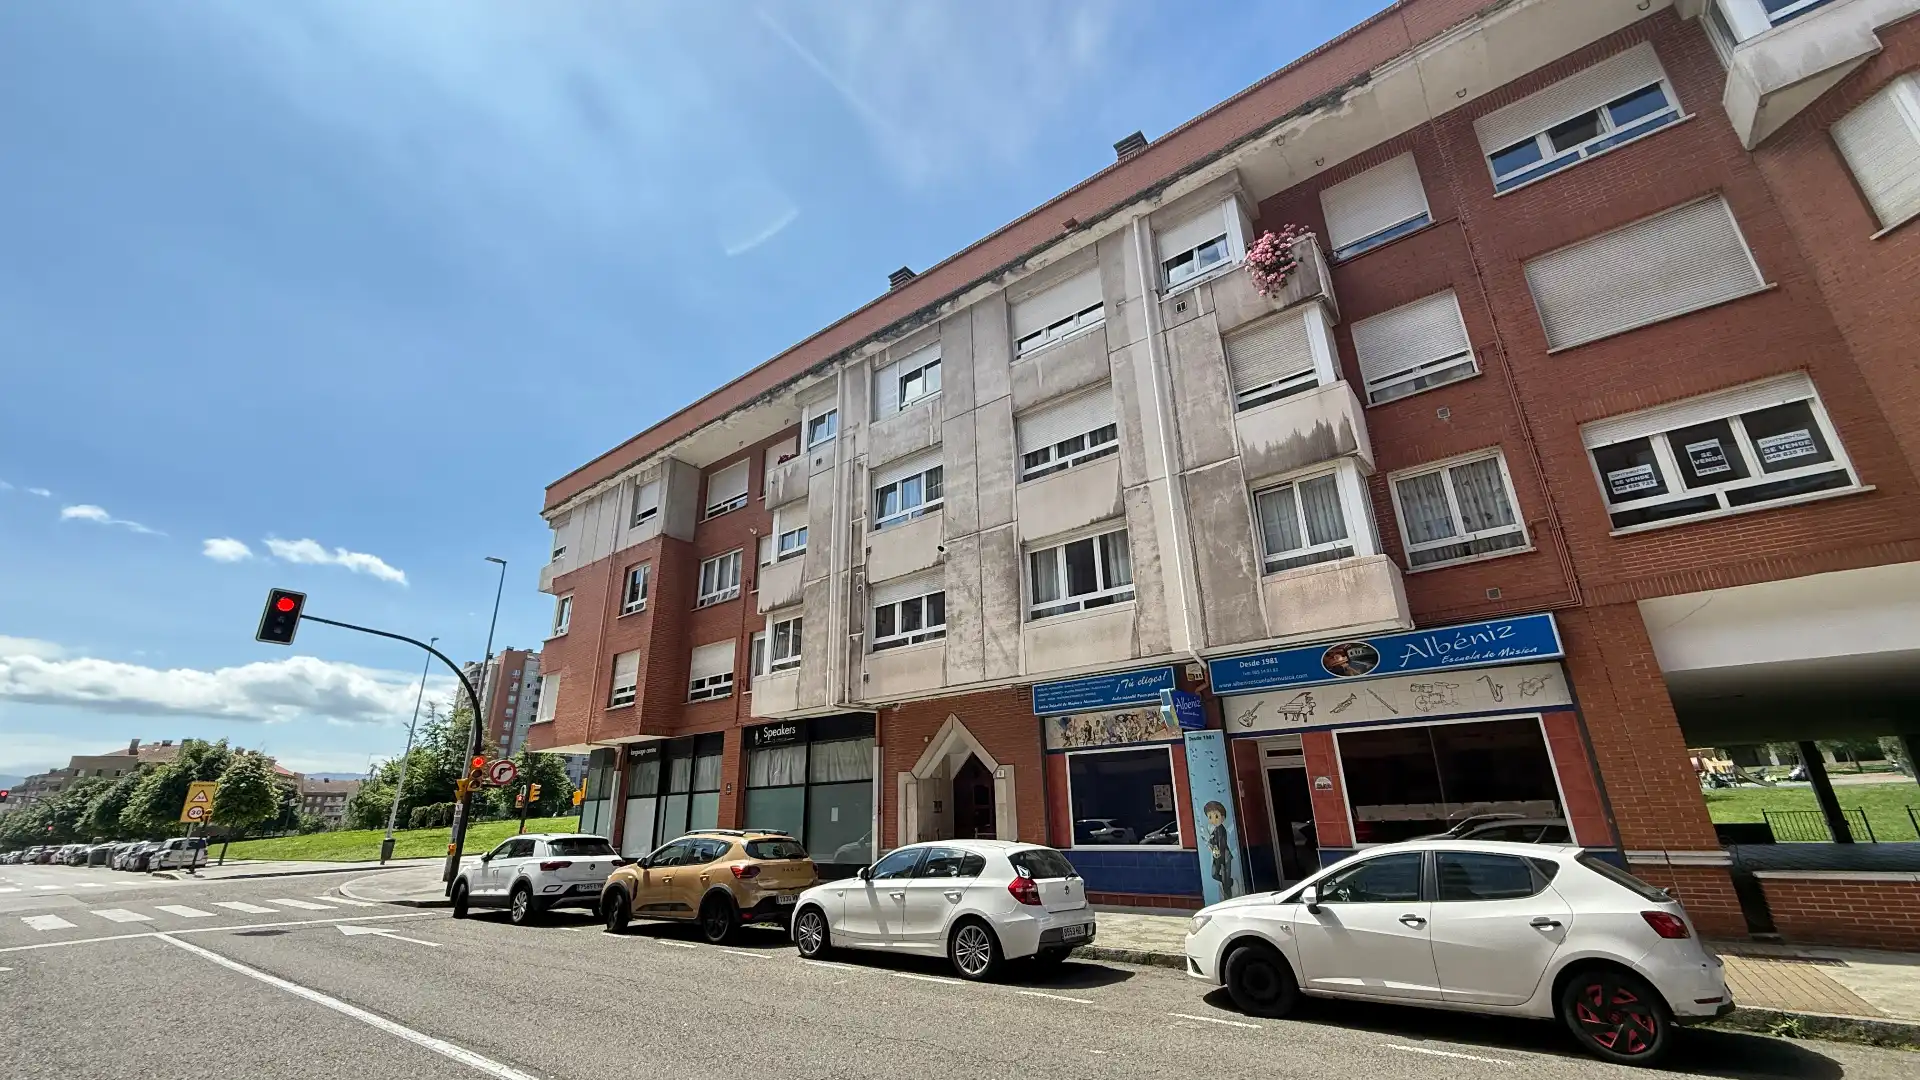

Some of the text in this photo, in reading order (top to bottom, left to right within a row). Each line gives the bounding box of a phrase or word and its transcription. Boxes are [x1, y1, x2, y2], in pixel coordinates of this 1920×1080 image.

[1778, 438, 1812, 450] VENDE
[1694, 454, 1724, 464] VENDE
[1626, 474, 1651, 484] VENDE
[1399, 624, 1517, 668] Albéniz
[1441, 646, 1538, 664] Escuela de Música
[1239, 657, 1278, 669] Desde 1981
[763, 724, 796, 741] Speakers
